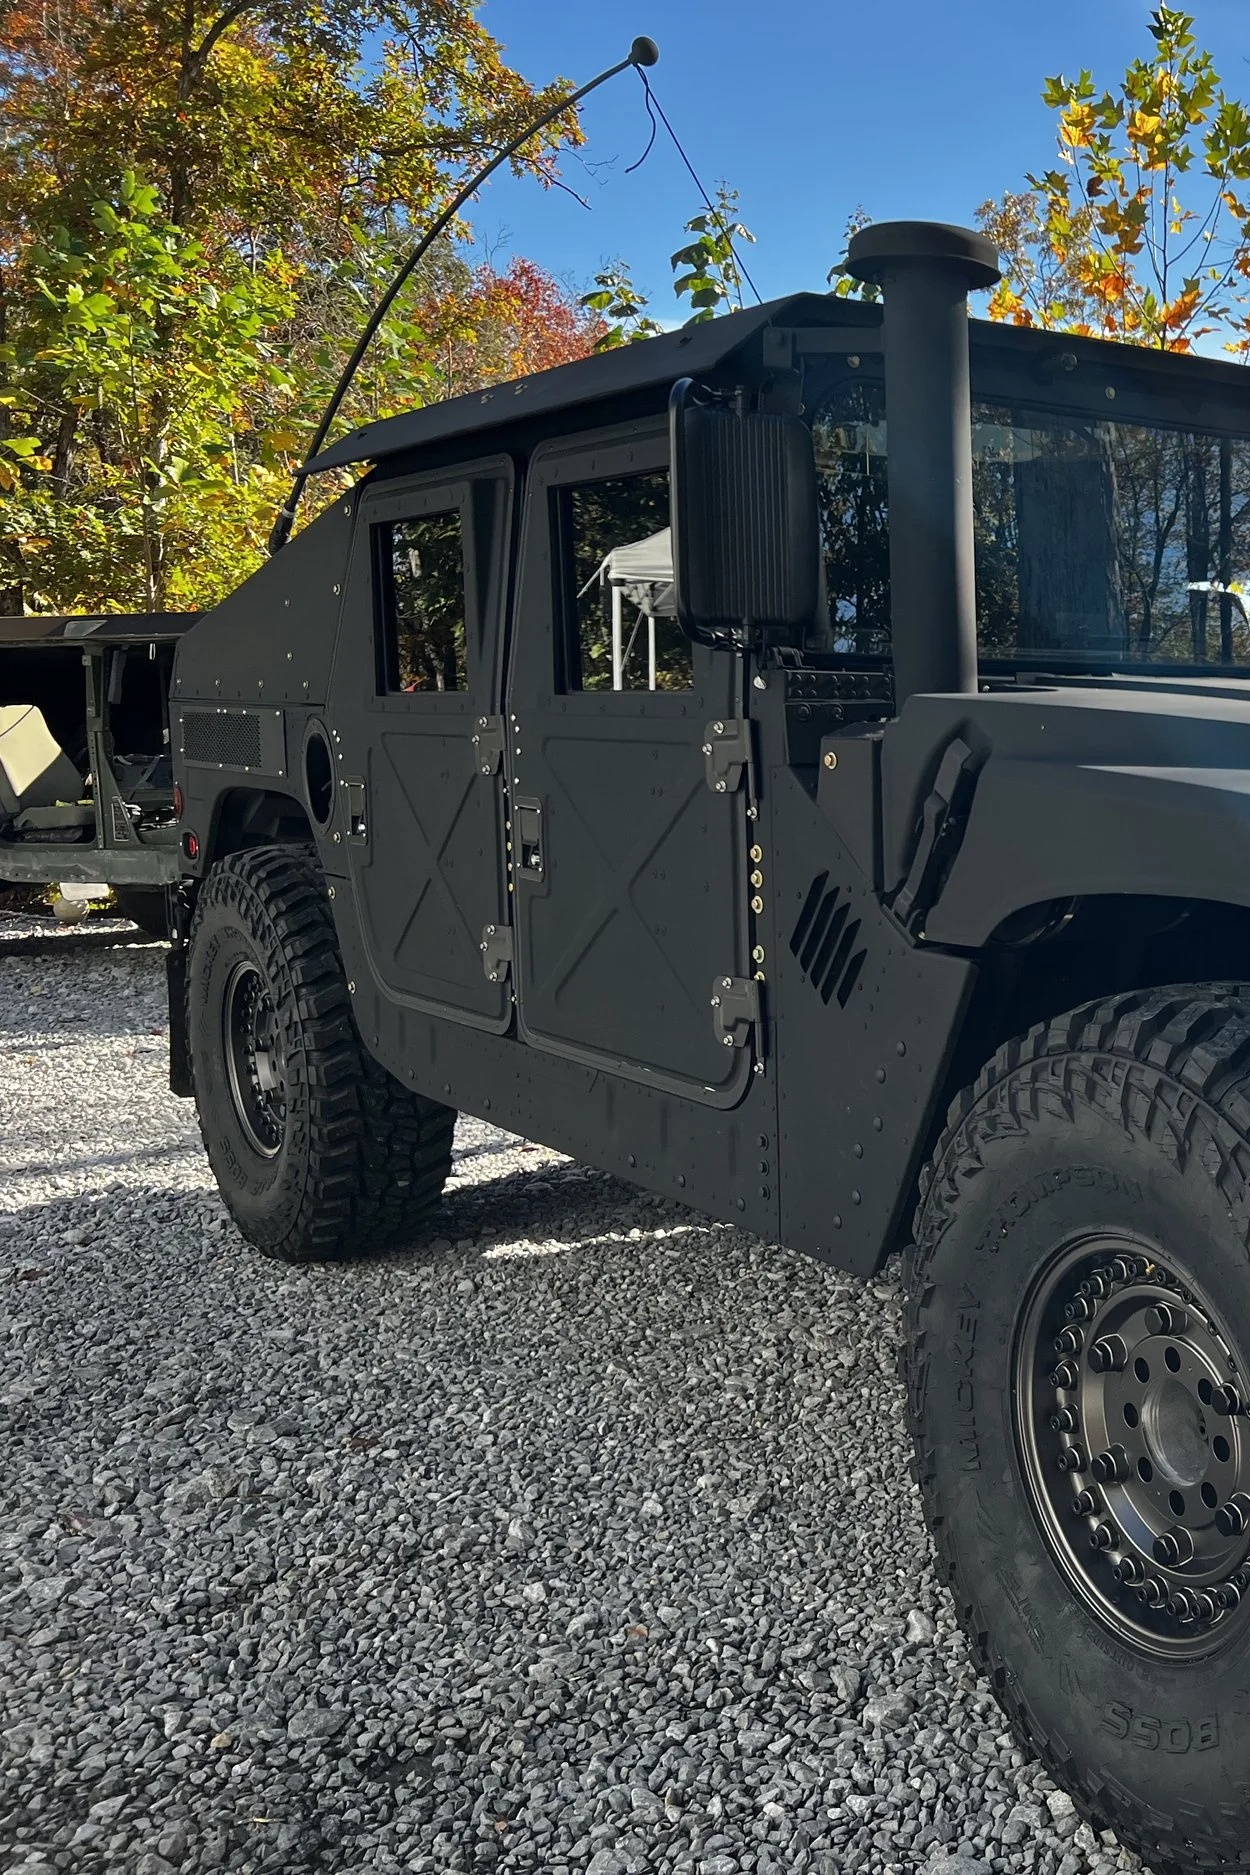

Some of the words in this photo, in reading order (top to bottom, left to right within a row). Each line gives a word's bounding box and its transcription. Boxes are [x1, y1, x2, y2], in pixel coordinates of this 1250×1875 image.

[219, 1135, 248, 1190] BOSS
[954, 1282, 981, 1471] MICKEY
[1099, 1699, 1220, 1754] BOSS
